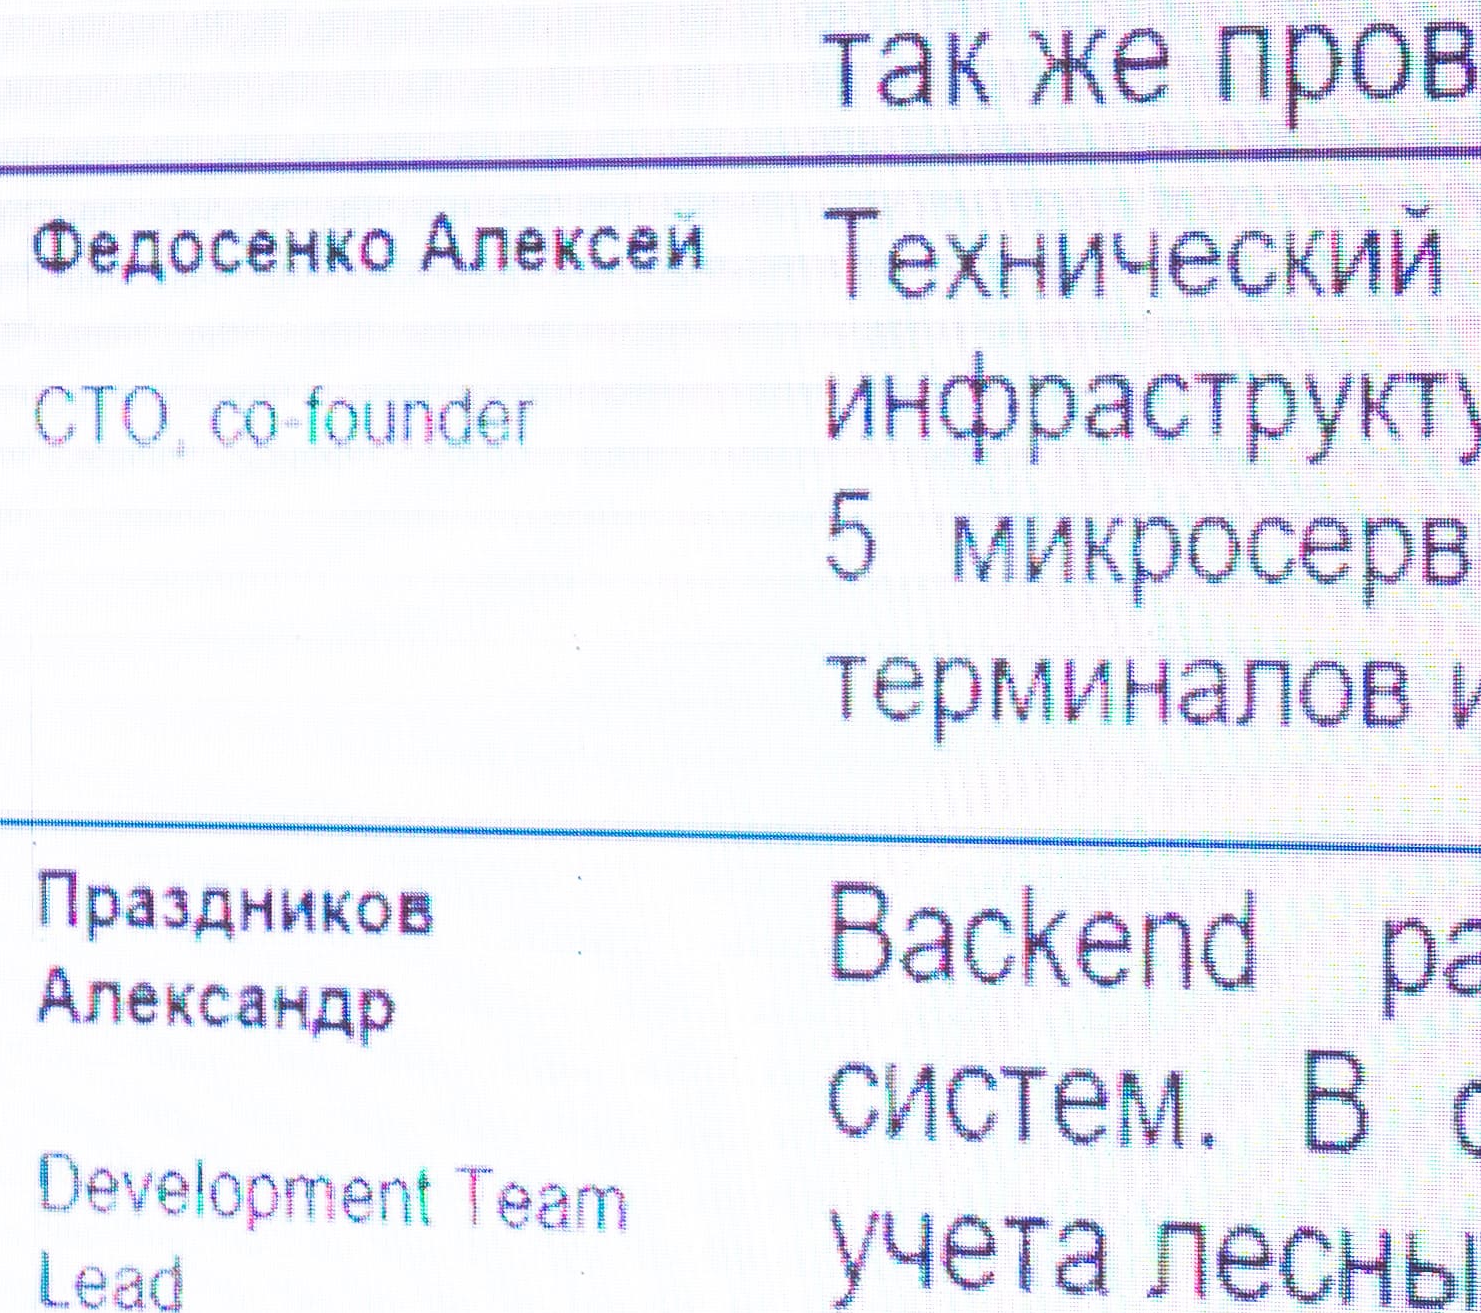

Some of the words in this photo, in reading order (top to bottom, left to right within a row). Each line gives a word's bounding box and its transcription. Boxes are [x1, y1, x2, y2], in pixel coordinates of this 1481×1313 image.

[821, 32, 991, 107] так
[1030, 28, 1169, 105] же
[1218, 22, 1479, 130] пров
[32, 216, 398, 285] Федосенко
[420, 210, 706, 272] Алексей
[824, 204, 1443, 300] Технический
[210, 385, 536, 448] co-founder
[827, 489, 877, 582] 5
[953, 516, 1473, 608] микросерв
[825, 656, 1411, 747] терминалов
[38, 868, 433, 942] Праздников
[831, 881, 1257, 991] Backend
[37, 965, 397, 1047] Александр
[829, 1062, 1214, 1149] систем.
[38, 1151, 433, 1231] Development
[455, 1164, 629, 1231] Team
[39, 1250, 184, 1312] Lead
[830, 1209, 1108, 1311] учета
[1147, 1222, 1478, 1311] лесны
